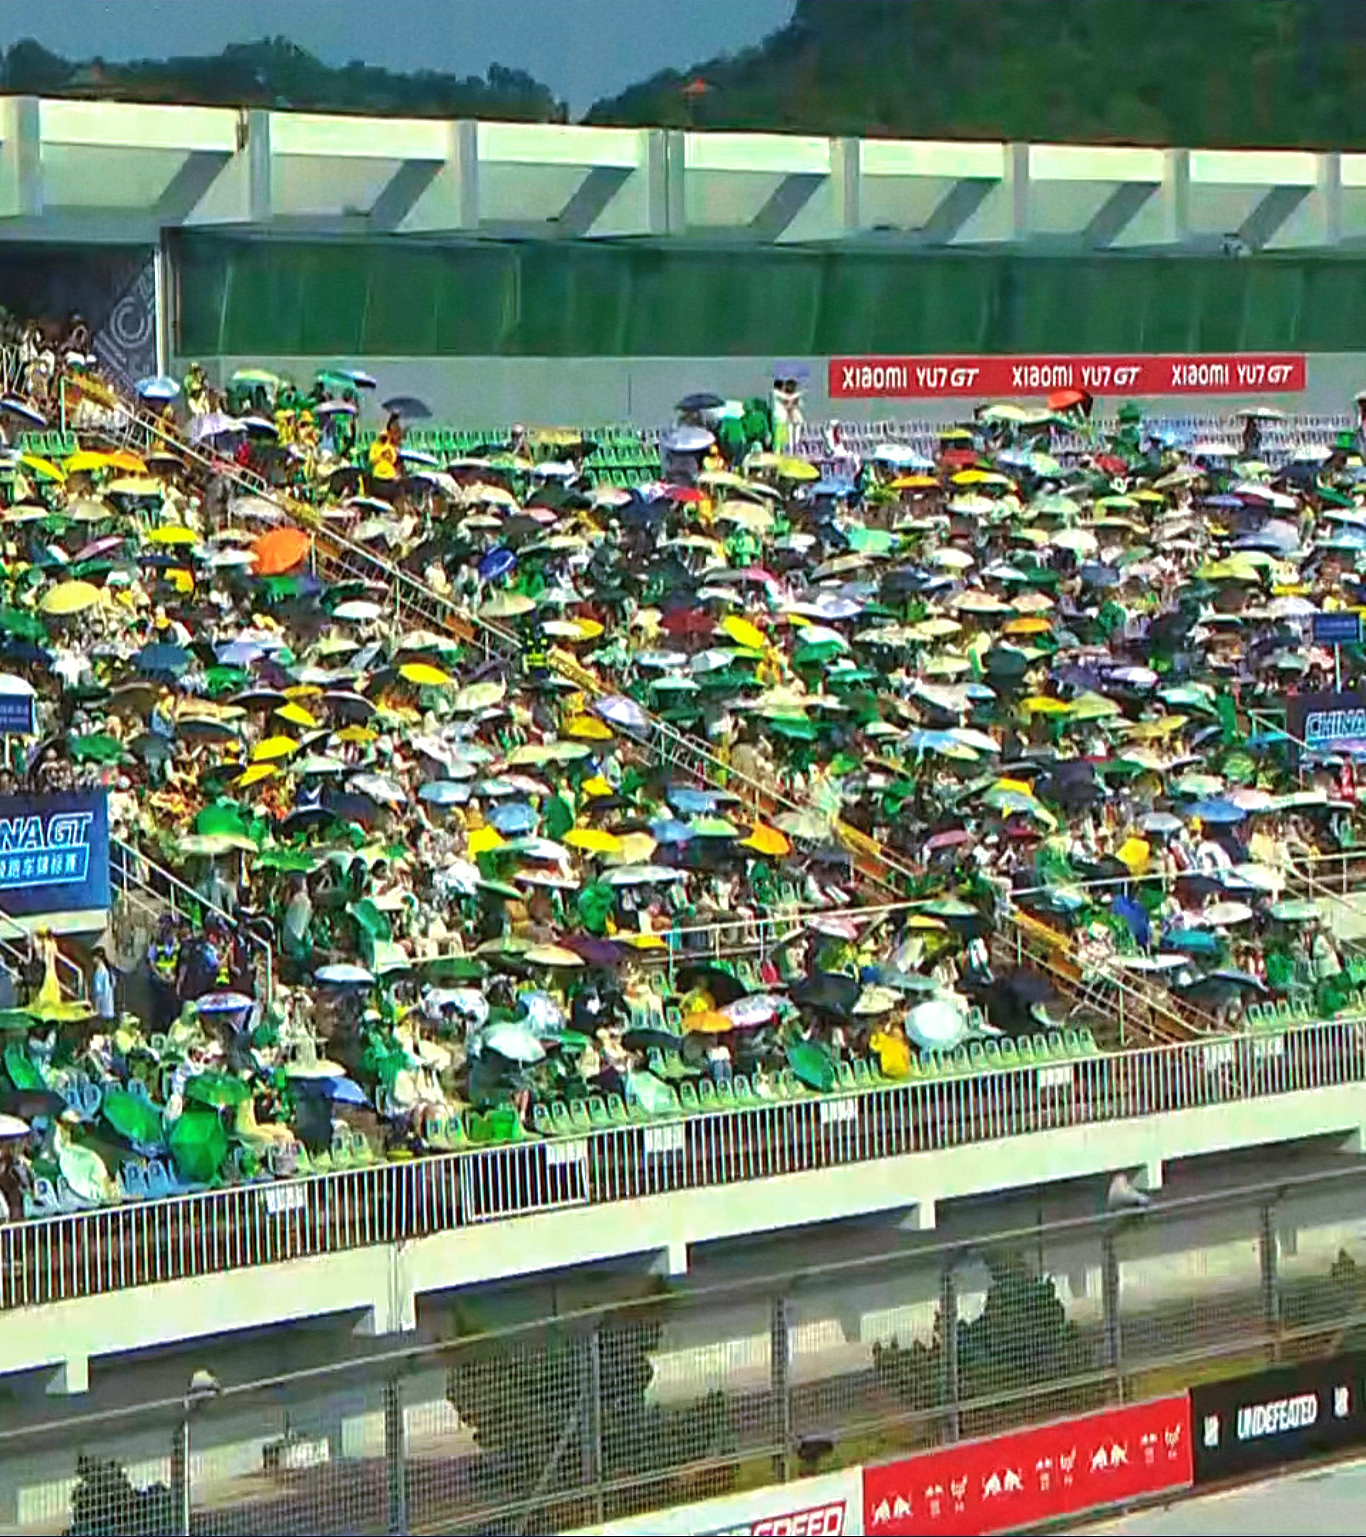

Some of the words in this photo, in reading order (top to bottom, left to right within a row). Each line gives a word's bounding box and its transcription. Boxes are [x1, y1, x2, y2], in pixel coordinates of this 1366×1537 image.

[951, 367, 979, 387] GT
[1113, 366, 1142, 385] GT
[1268, 364, 1293, 384] GT
[46, 811, 93, 849] GT
[1237, 1393, 1319, 1441] UNDEFEATED
